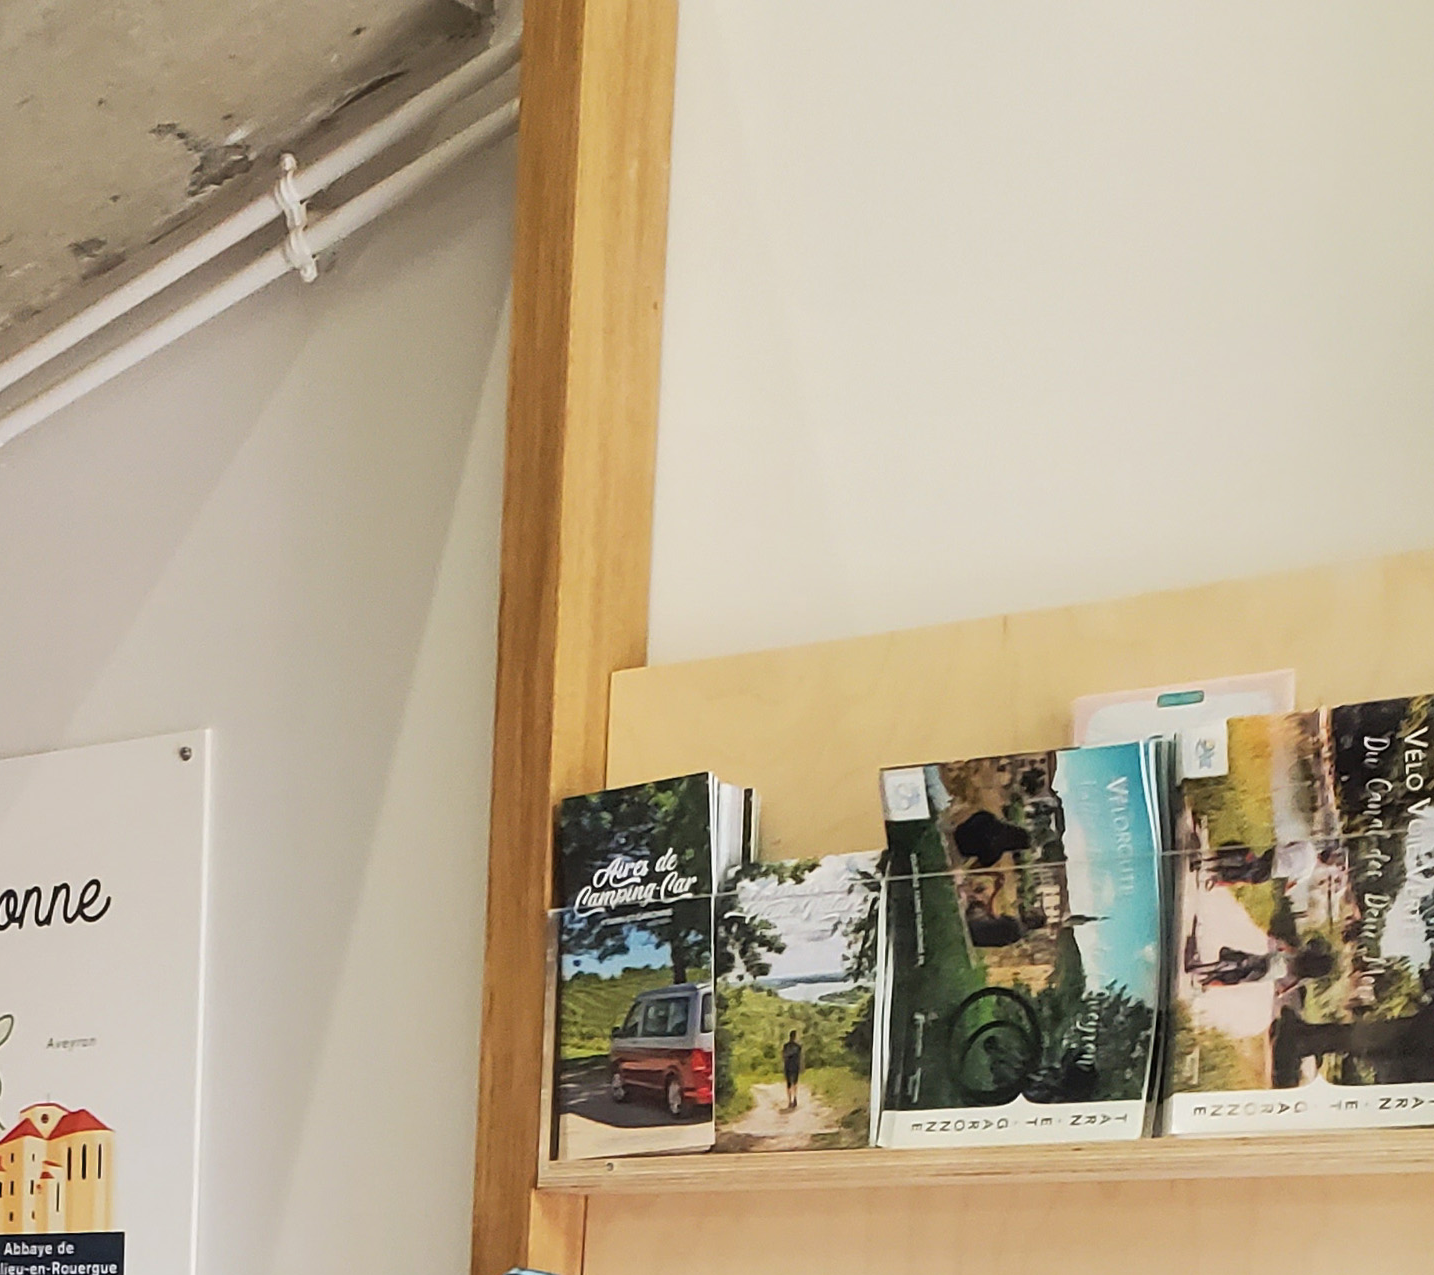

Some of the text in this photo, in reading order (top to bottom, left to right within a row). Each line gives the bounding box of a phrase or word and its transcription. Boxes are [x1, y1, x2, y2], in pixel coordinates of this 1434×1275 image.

[593, 848, 678, 888] Aires de
[574, 872, 698, 918] Camping-Car
[45, 1035, 97, 1051] Aveyron
[911, 1113, 1128, 1132] TARN ET GARONNE
[3, 1241, 75, 1257] Abbaye de
